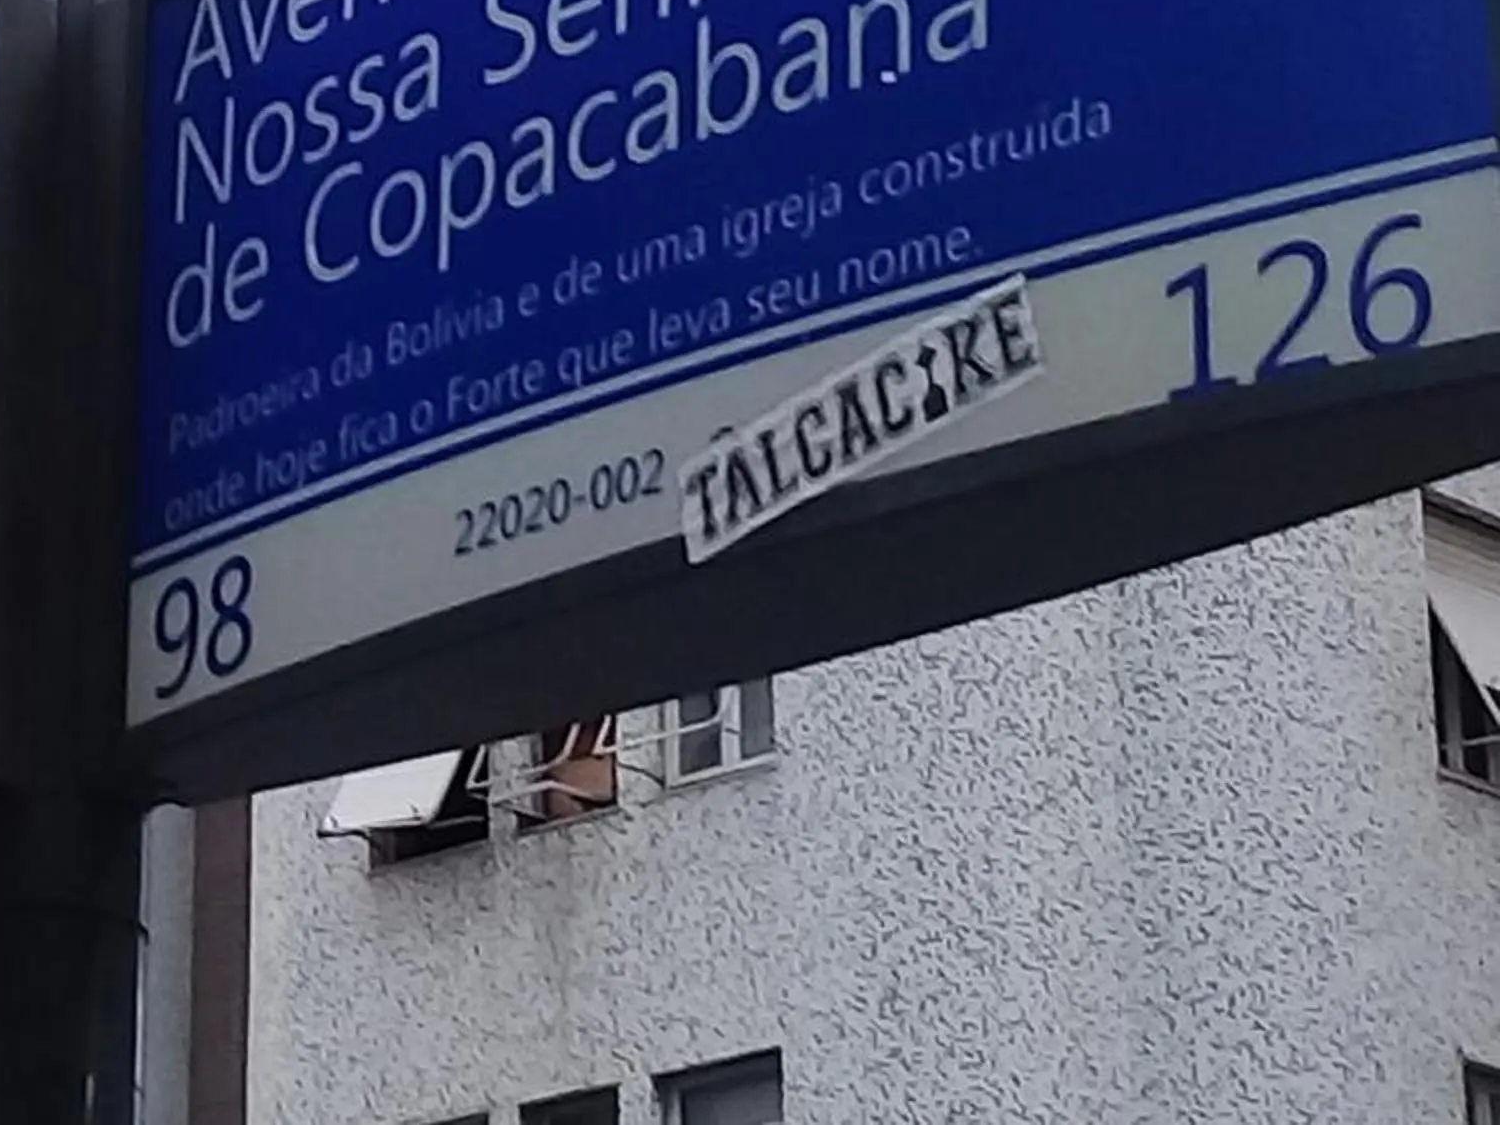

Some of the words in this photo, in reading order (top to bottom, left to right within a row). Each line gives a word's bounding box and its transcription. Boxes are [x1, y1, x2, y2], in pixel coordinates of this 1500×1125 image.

[175, 33, 442, 223] Nossa
[164, 468, 246, 532] onde
[255, 437, 329, 497] hoje
[338, 410, 399, 461] fica
[409, 398, 435, 437] o
[446, 357, 547, 423] Forte
[556, 328, 635, 388] que
[648, 296, 732, 356] leva
[746, 268, 822, 323] seu
[836, 224, 984, 296] nome.
[167, 222, 269, 349] de
[169, 365, 321, 455] Padroeira
[329, 339, 374, 388] da
[517, 281, 541, 318] e
[553, 255, 603, 307] de
[616, 225, 706, 285] uma
[721, 177, 843, 259] igreja
[1165, 212, 1433, 403] 126
[454, 447, 666, 556] 22020-002
[154, 554, 252, 700] 98
